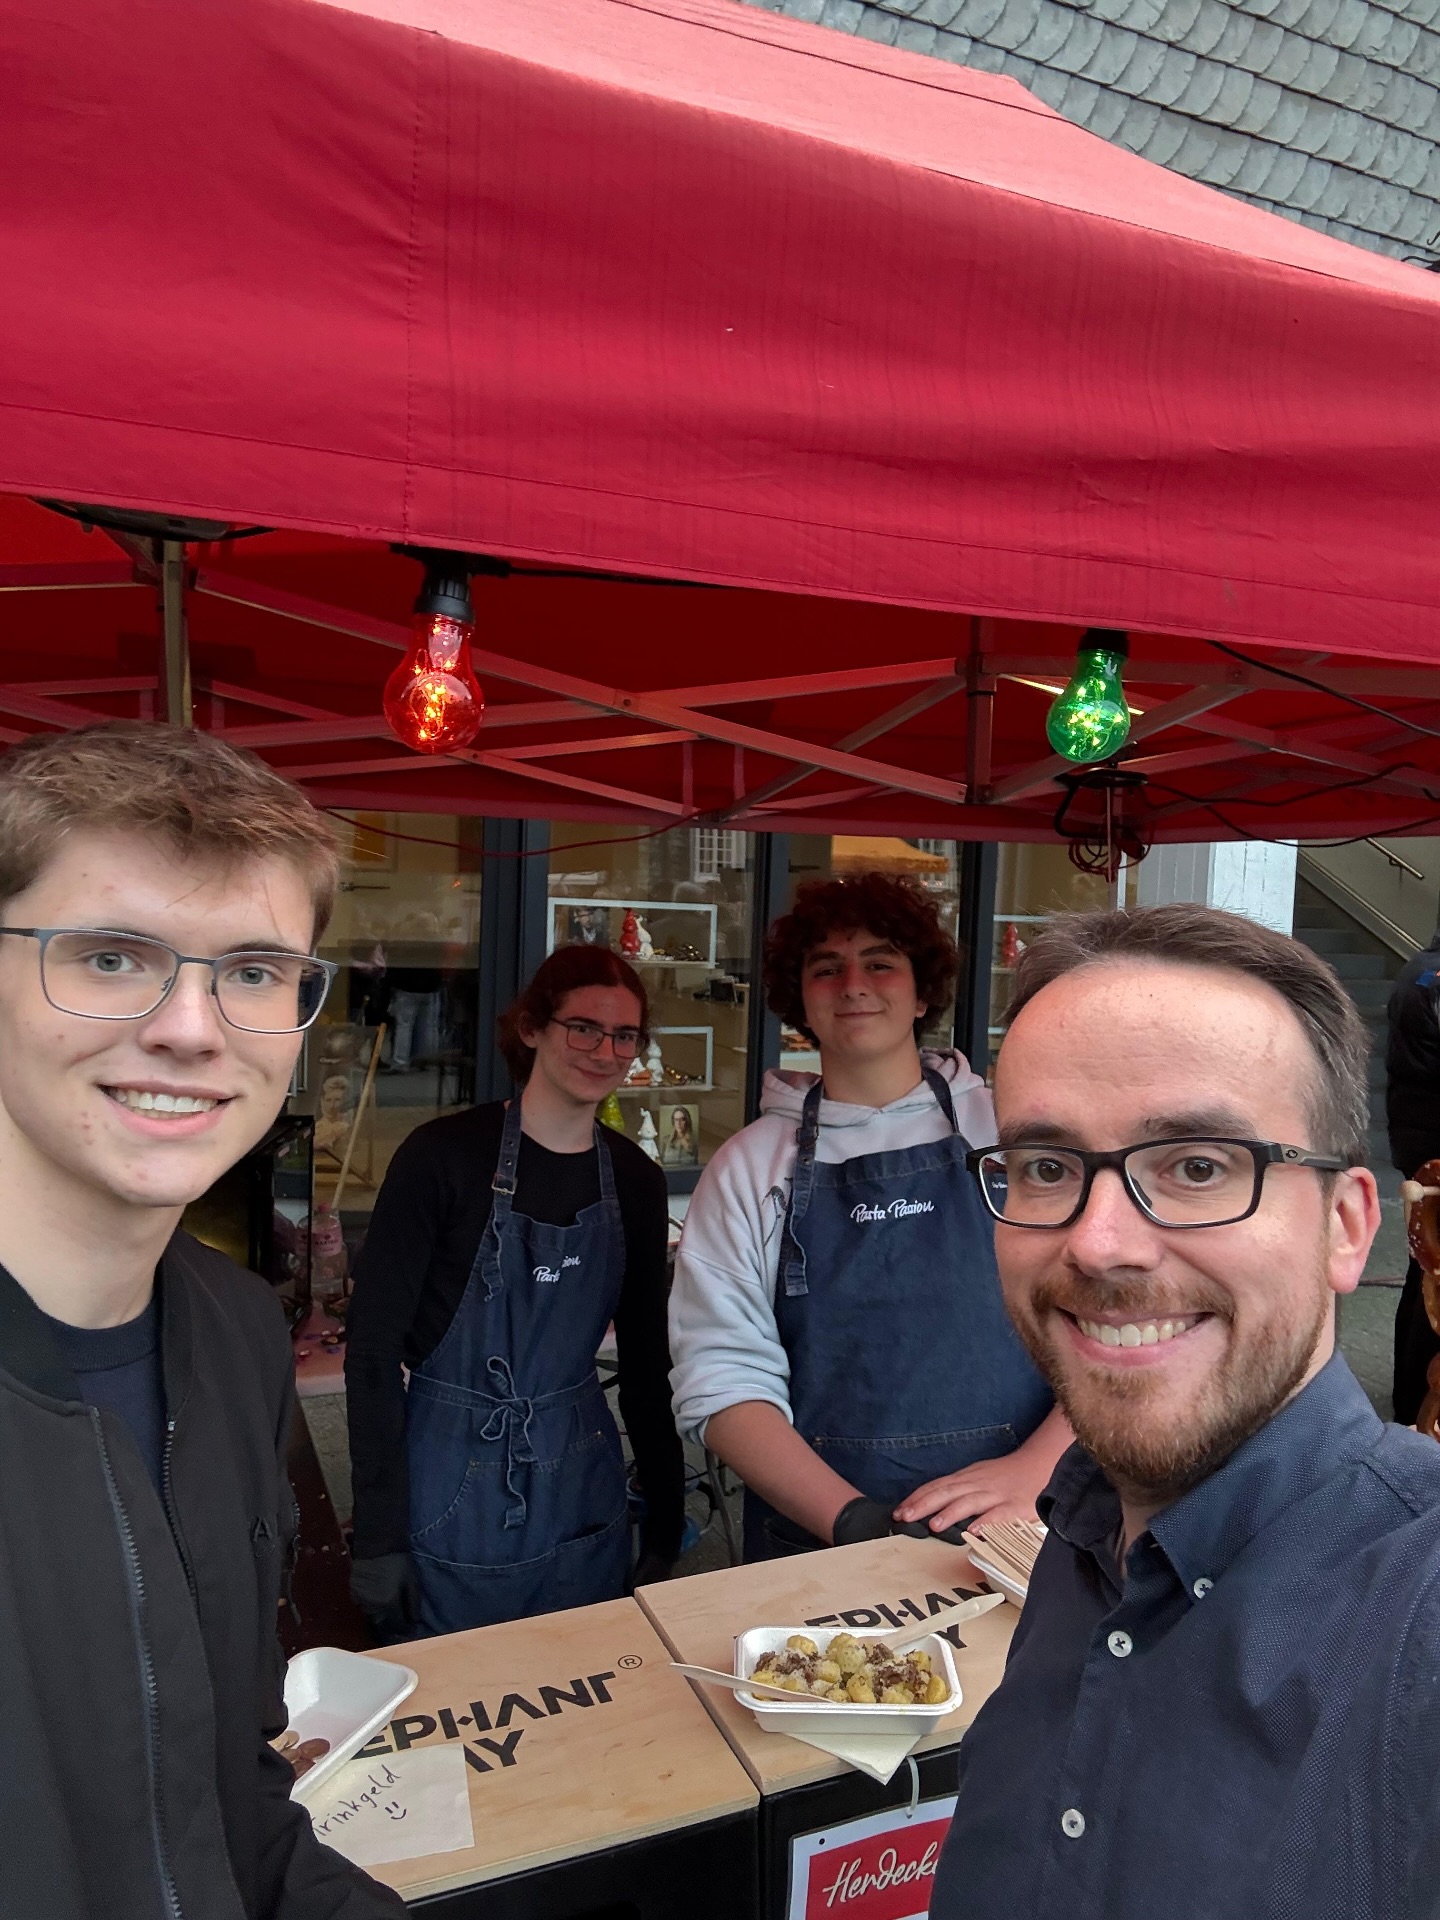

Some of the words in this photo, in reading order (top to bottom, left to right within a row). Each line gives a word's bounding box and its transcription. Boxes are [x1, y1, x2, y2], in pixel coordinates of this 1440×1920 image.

[850, 1203, 886, 1223] Pasta
[887, 1199, 935, 1218] Passion
[532, 1266, 560, 1283] Past
